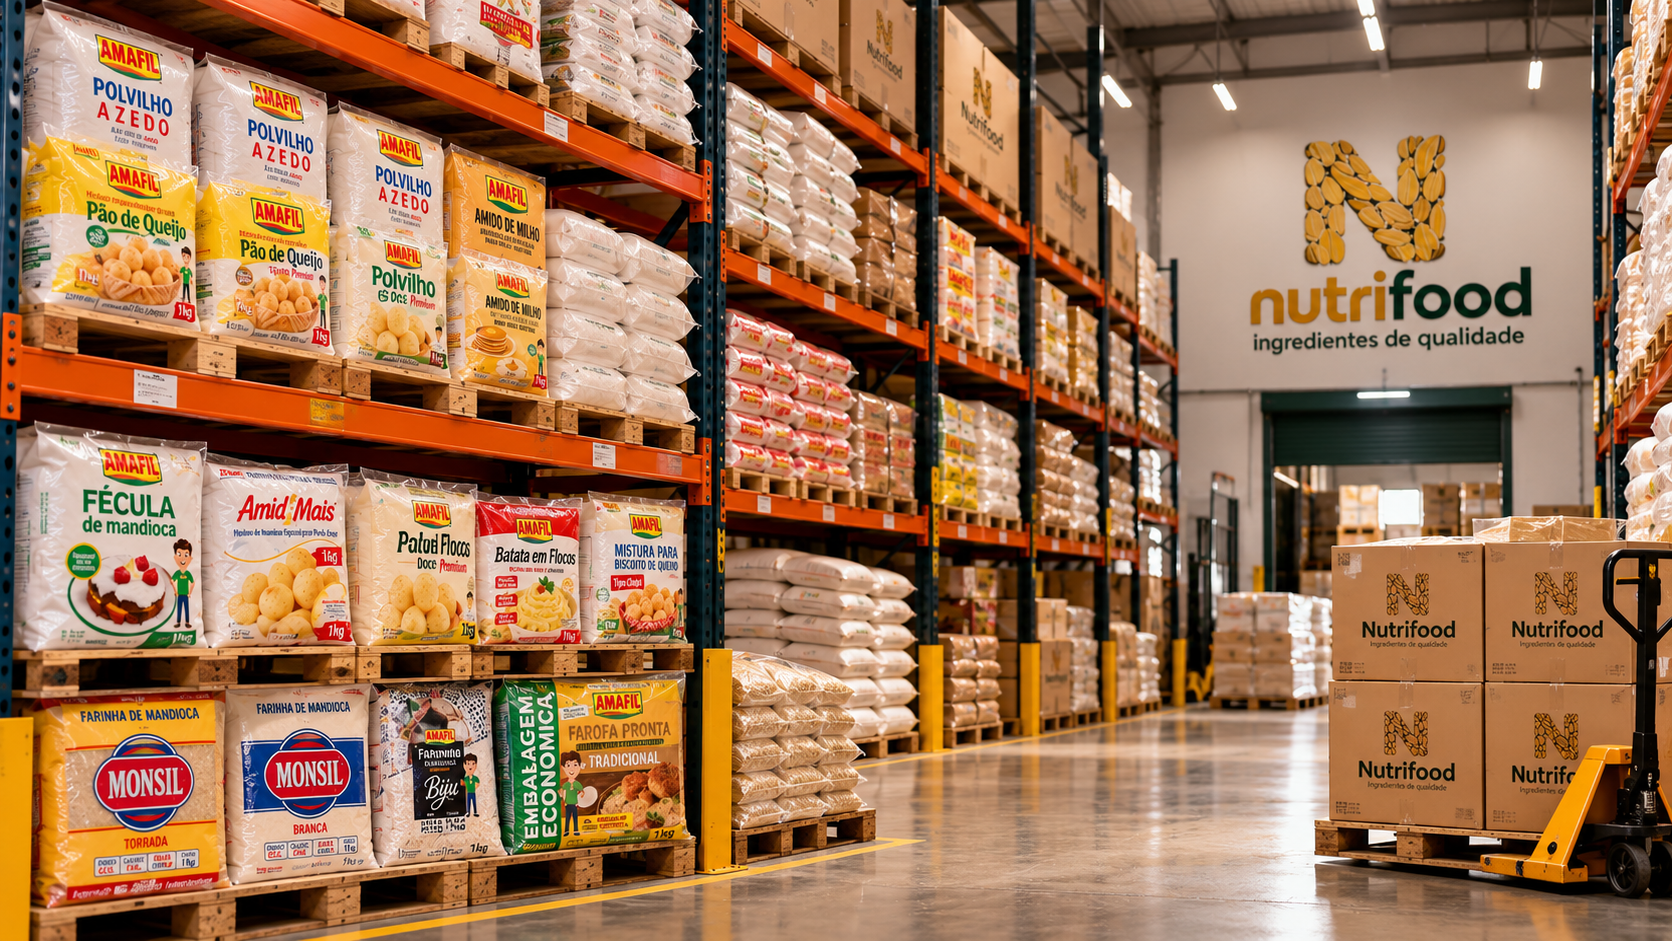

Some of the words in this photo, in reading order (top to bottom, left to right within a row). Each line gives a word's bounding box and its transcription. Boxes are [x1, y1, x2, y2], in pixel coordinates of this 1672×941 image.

[101, 39, 160, 74] AMAFIL
[867, 39, 903, 80] Nutrifood
[93, 76, 173, 117] POLVILHO
[255, 85, 301, 116] AMAFIL
[97, 102, 169, 136] AZEDO
[961, 100, 1004, 151] Nutrifood
[248, 118, 314, 154] POLVILHO
[381, 132, 421, 161] AMAFIL
[252, 142, 311, 172] AZEDO
[109, 164, 160, 193] AMAFIL
[375, 165, 432, 198] POLVILHO
[378, 186, 429, 214] AZEDO
[489, 179, 526, 207] AMAFIL
[86, 200, 118, 224] Pão
[121, 209, 140, 230] de
[143, 213, 186, 242] Queijo
[256, 201, 303, 228] AMAFIL
[474, 207, 503, 231] AMIDO
[504, 216, 515, 234] DE
[517, 220, 540, 242] MILHO
[240, 239, 266, 260] Pão
[269, 244, 285, 263] de
[287, 247, 323, 271] Queijo
[387, 243, 421, 264] AMAFIL
[371, 265, 436, 298] Polvilho
[496, 273, 529, 293] AMAFIL
[485, 295, 510, 312] AMIDO
[511, 300, 520, 314] DE
[521, 302, 541, 320] MILHO
[1250, 266, 1532, 324] nutrifood
[1253, 332, 1378, 354] ingredientes
[1385, 329, 1411, 347] de
[1418, 326, 1524, 350] qualidade
[104, 451, 160, 476] AMAFIL
[82, 484, 176, 519] FÉCULA
[292, 497, 335, 522] Mais
[415, 502, 450, 521] AMAFIL
[82, 515, 102, 533] de
[106, 519, 177, 537] mandioca
[518, 520, 552, 536] AMAFIL
[632, 516, 662, 532] AMAFIL
[417, 557, 437, 570] Doce
[494, 546, 530, 563] Batata
[532, 551, 547, 564] em
[614, 543, 655, 558] MISTURA
[657, 545, 678, 560] PARA
[614, 559, 646, 571] BISCOITO
[647, 560, 656, 571] DE
[328, 623, 345, 641] 1kg
[1362, 620, 1455, 638] Nutrifood
[1512, 620, 1603, 638] Nutrifood
[80, 710, 127, 722] FARINHA
[129, 709, 143, 721] DE
[145, 707, 200, 721] MANDIOCA
[295, 702, 306, 714] DE
[596, 694, 641, 711] AMAFIL
[426, 730, 454, 741] AMAFIL
[568, 723, 619, 741] FAROFA
[622, 721, 671, 739] PRONTA
[518, 695, 539, 840] EMBALAGEM
[588, 751, 661, 769] TRADICIONAL
[1358, 760, 1455, 782] Nutrifood
[108, 767, 184, 799] MONSIL
[275, 760, 344, 788] MONSIL
[1512, 765, 1576, 785] Nutrifo
[424, 775, 459, 811] Biju
[293, 822, 328, 835] BRANCA
[124, 836, 168, 849] TORRADA
